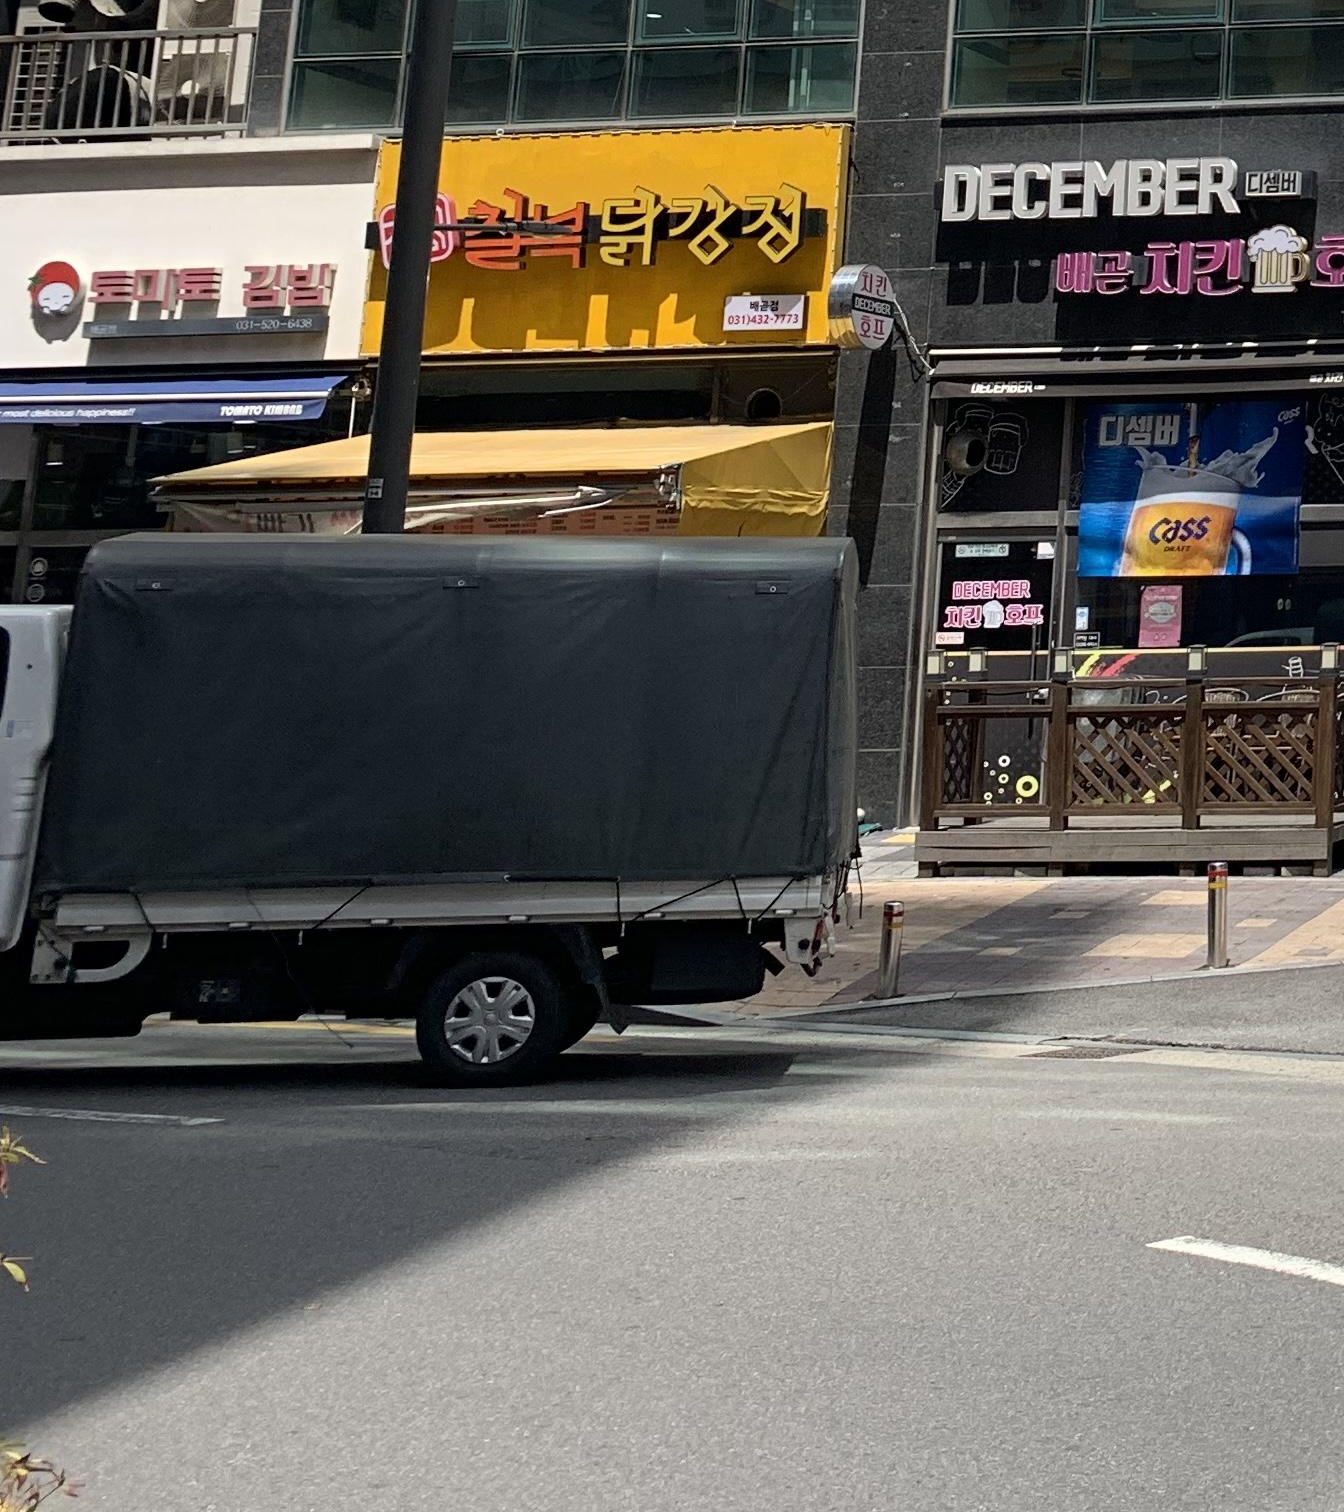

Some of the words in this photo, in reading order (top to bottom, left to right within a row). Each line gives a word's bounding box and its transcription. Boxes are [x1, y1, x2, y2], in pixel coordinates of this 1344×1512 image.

[940, 157, 1241, 223] DECEMBER
[1246, 171, 1301, 197] 디셈버
[599, 182, 807, 268] 닭강정
[1055, 249, 1134, 295] 배곧
[1140, 237, 1246, 297] 치킨
[88, 267, 221, 311] 토마토
[243, 263, 334, 309] 김밥
[861, 271, 888, 297] 치킨
[854, 296, 892, 316] DECEMBER
[235, 317, 313, 331] 031-520-6438
[859, 315, 886, 341] 호프
[1098, 414, 1181, 448] 디셈버
[951, 579, 1032, 601] DECEMBER
[943, 604, 983, 629] 치킨
[1003, 603, 1045, 627] 호프
